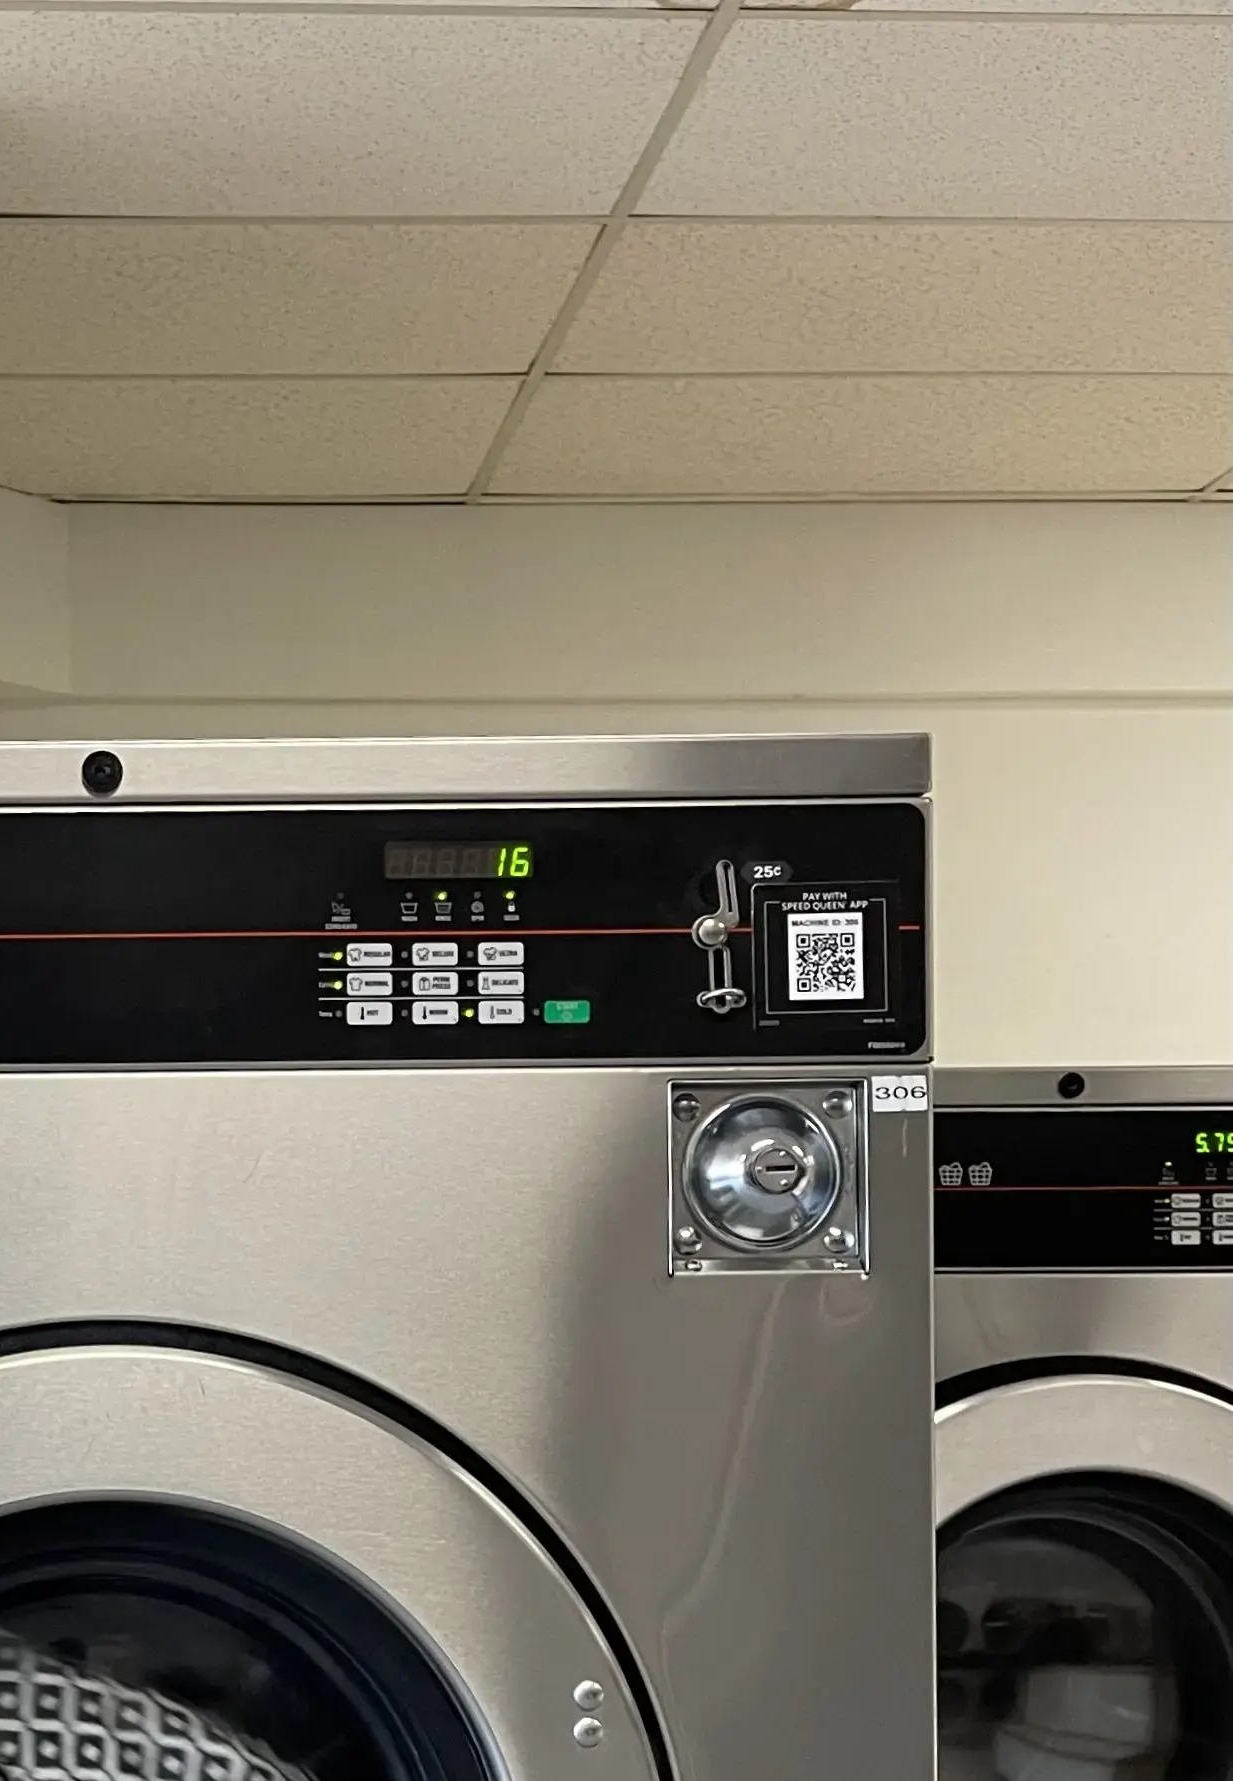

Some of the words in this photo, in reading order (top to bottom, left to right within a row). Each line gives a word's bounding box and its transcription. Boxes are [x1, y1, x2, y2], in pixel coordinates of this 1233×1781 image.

[497, 846, 529, 877] 16
[753, 866, 782, 879] 25¢
[802, 892, 821, 901] PAY
[822, 891, 847, 901] WITH
[781, 901, 811, 912] SPEED
[812, 900, 846, 911] QUEEN
[849, 900, 869, 910] APP
[875, 1086, 927, 1099] 306
